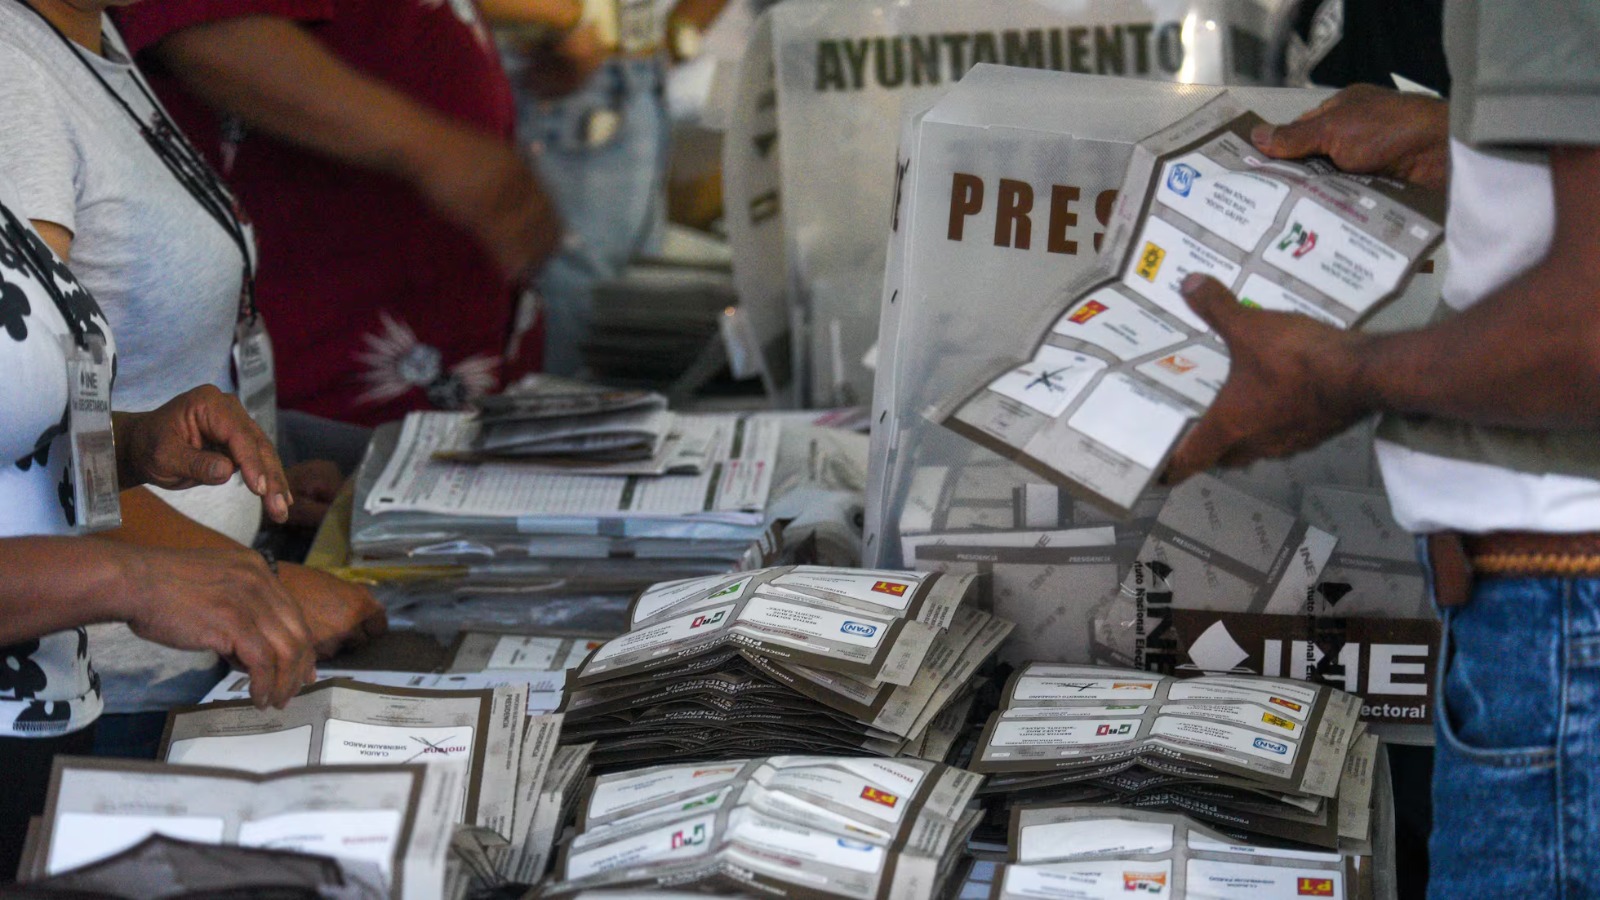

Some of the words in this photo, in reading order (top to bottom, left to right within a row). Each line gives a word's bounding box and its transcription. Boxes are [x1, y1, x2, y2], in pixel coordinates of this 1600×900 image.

[815, 25, 1188, 91] AYUNTAMIENTO
[85, 372, 98, 390] INE
[956, 553, 998, 562] PRESIDENCIA
[1299, 546, 1317, 578] INE
[874, 582, 906, 592] PT
[1136, 588, 1146, 635] Nacional
[793, 617, 817, 625] BERTHA
[848, 625, 870, 634] PAN
[755, 646, 790, 657] PROCESO
[666, 679, 752, 691] PRESIDENCIA
[671, 685, 702, 693] FEDERAL
[631, 691, 668, 704] 2023-2024
[502, 693, 513, 729] PRESIDENCIA
[343, 740, 366, 748] PARDO
[531, 723, 548, 758] PRESIDENCIA
[1259, 741, 1281, 750] PAN
[369, 742, 407, 751] SHEINBAUM
[424, 745, 466, 756] morena
[359, 750, 390, 758] CLAUDIA
[873, 763, 913, 784] morena
[864, 787, 897, 803] PT
[1134, 799, 1169, 807] FEDERAL
[1170, 800, 1212, 815] ELECTORAL
[1214, 813, 1249, 824] PROCESO
[1300, 880, 1330, 890] PT
